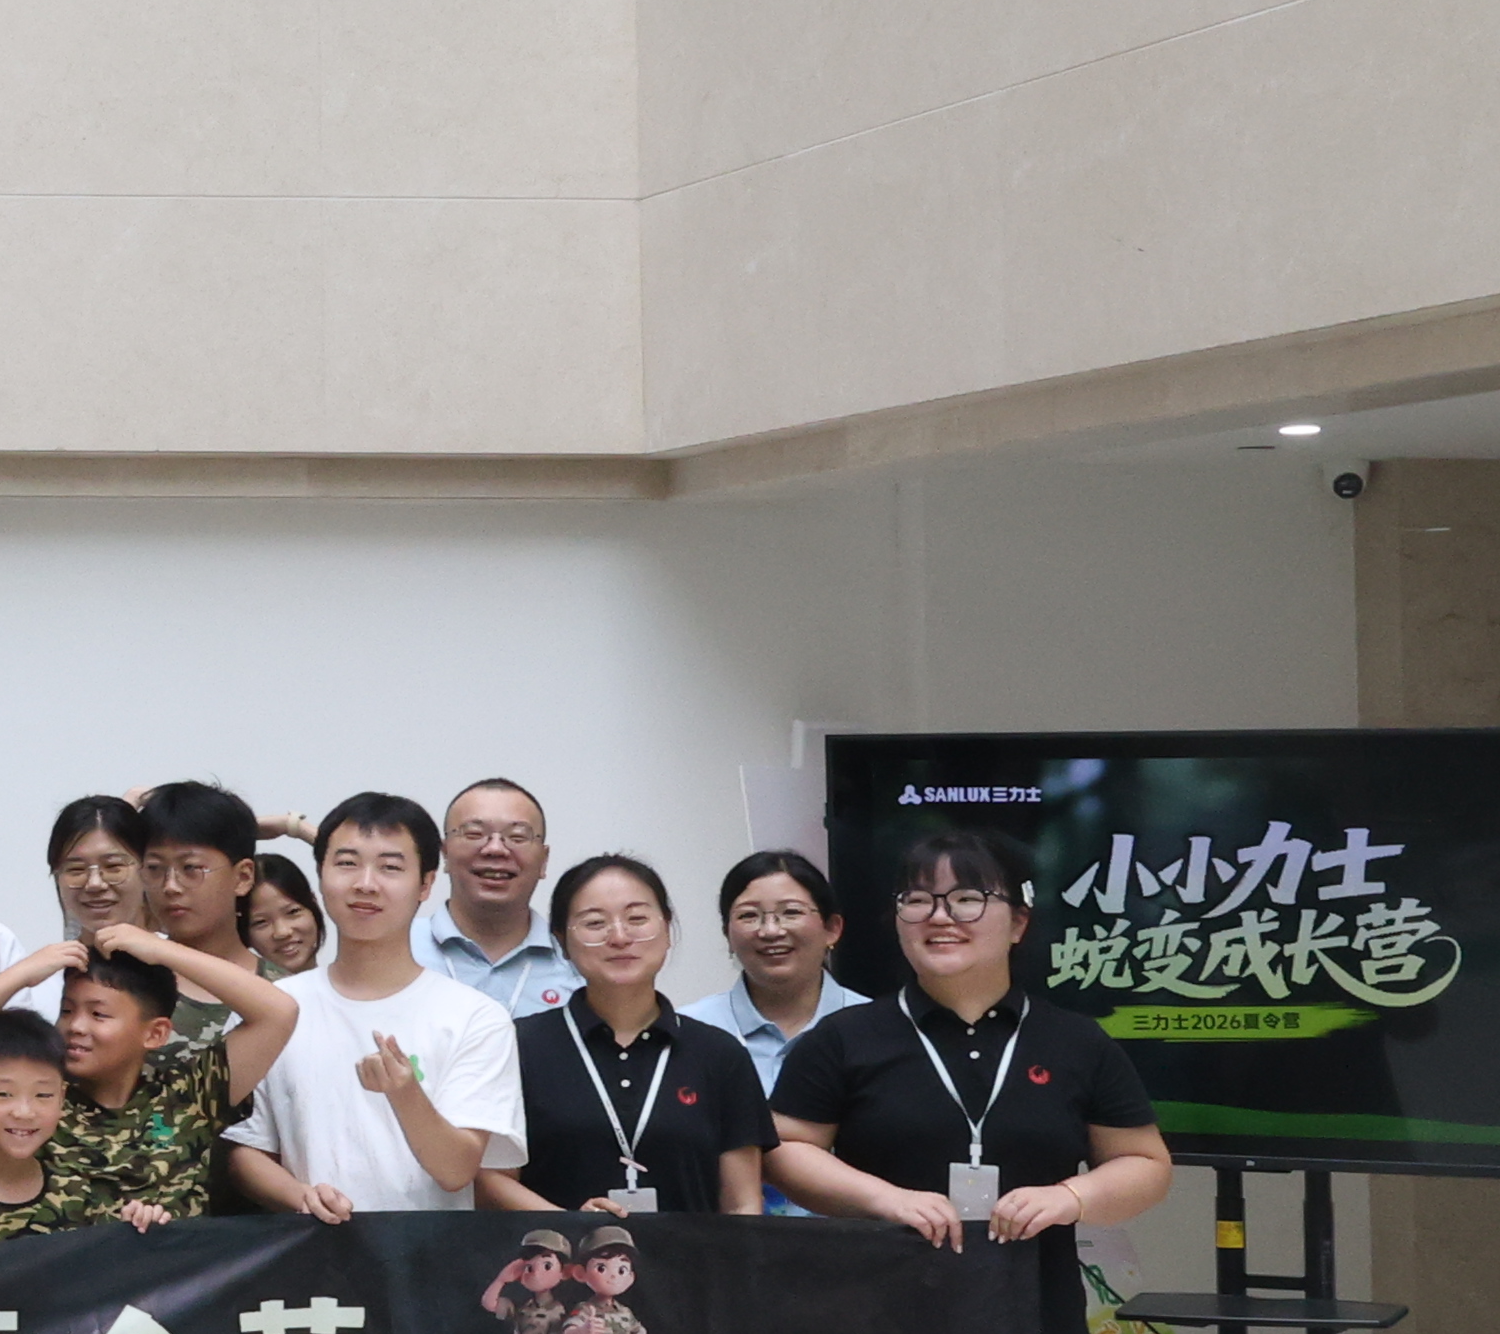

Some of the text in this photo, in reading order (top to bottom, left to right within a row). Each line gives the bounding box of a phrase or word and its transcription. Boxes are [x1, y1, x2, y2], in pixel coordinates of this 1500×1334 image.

[1062, 821, 1405, 918] 小小力士
[1047, 898, 1461, 1007] 蜕变成长营
[1133, 1012, 1300, 1030] 三力士2026夏令营
